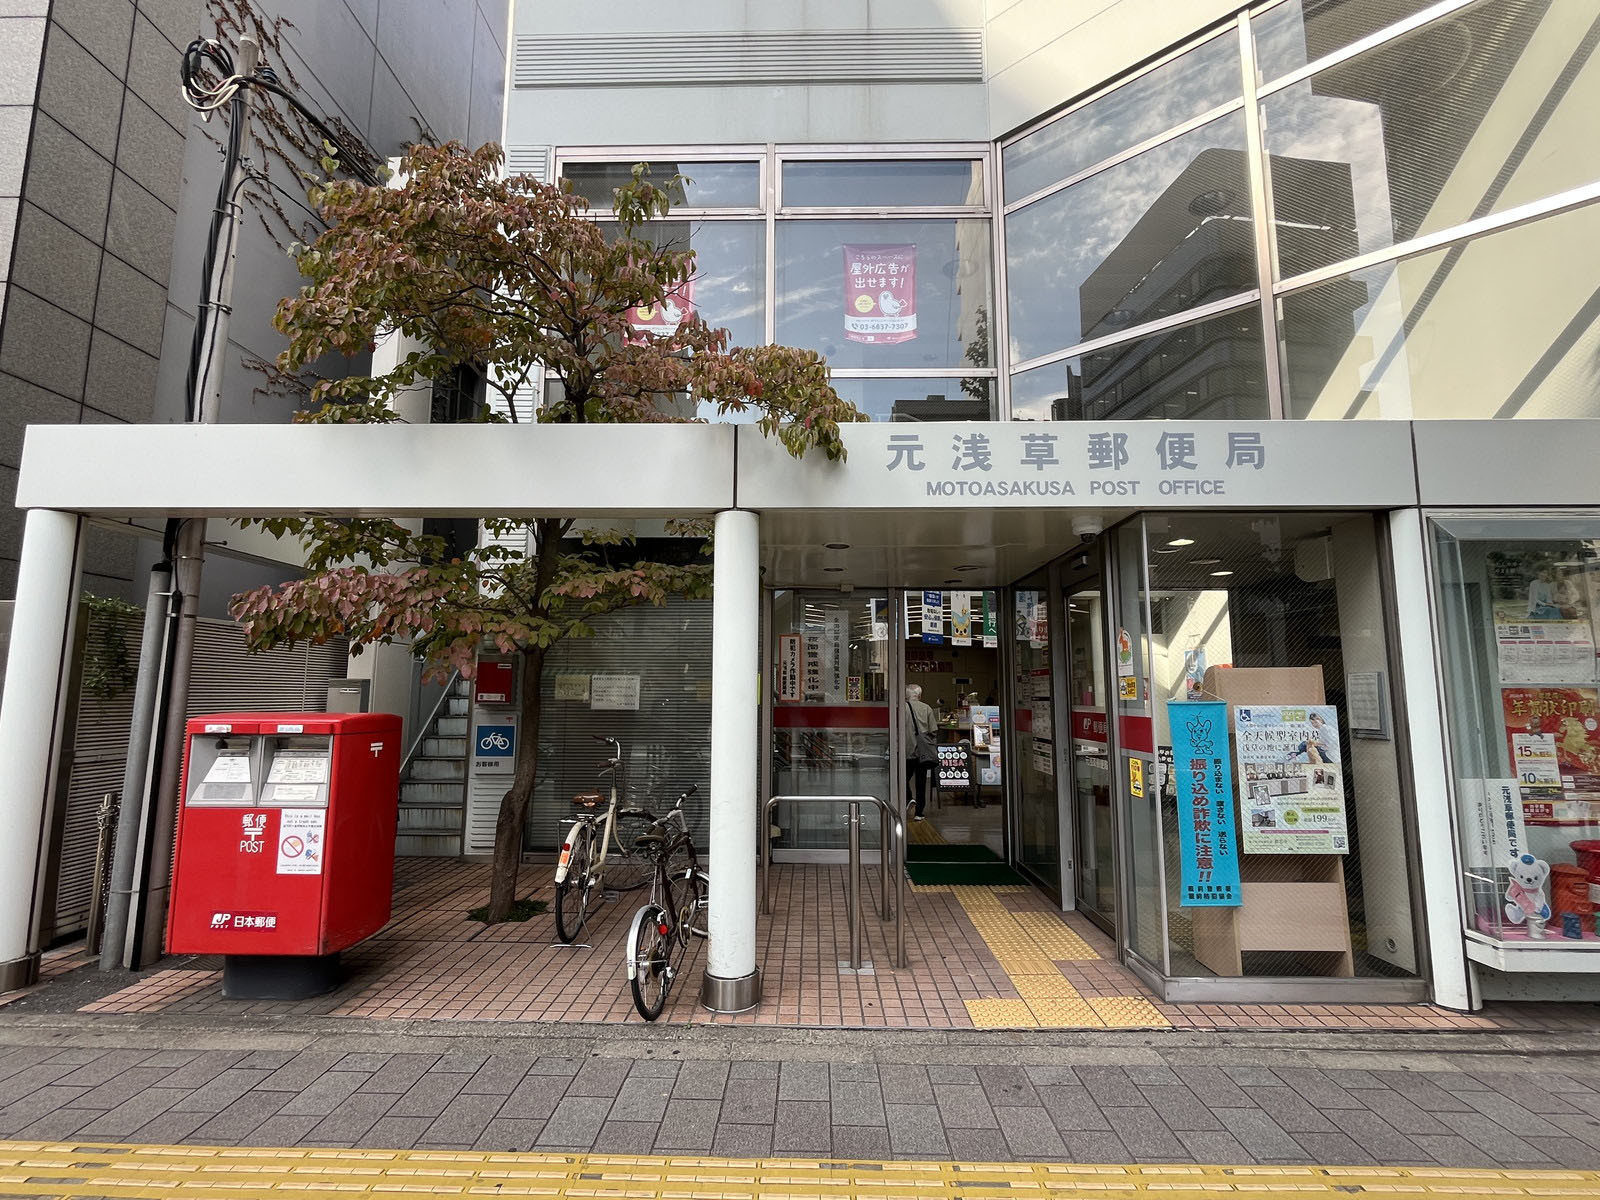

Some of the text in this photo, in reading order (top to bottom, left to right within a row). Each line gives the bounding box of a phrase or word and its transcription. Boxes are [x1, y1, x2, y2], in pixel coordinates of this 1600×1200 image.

[850, 262, 910, 275] 屋外広告が
[886, 432, 1265, 471] 元浅草郵便局
[926, 480, 1225, 496] MOTOASAKUSA POST OFFICE
[1511, 700, 1598, 717] 年賀状印刷
[242, 813, 267, 828] 郵便
[1312, 814, 1328, 823] 199
[240, 840, 264, 853] POST
[234, 915, 276, 928] 日本郵便
